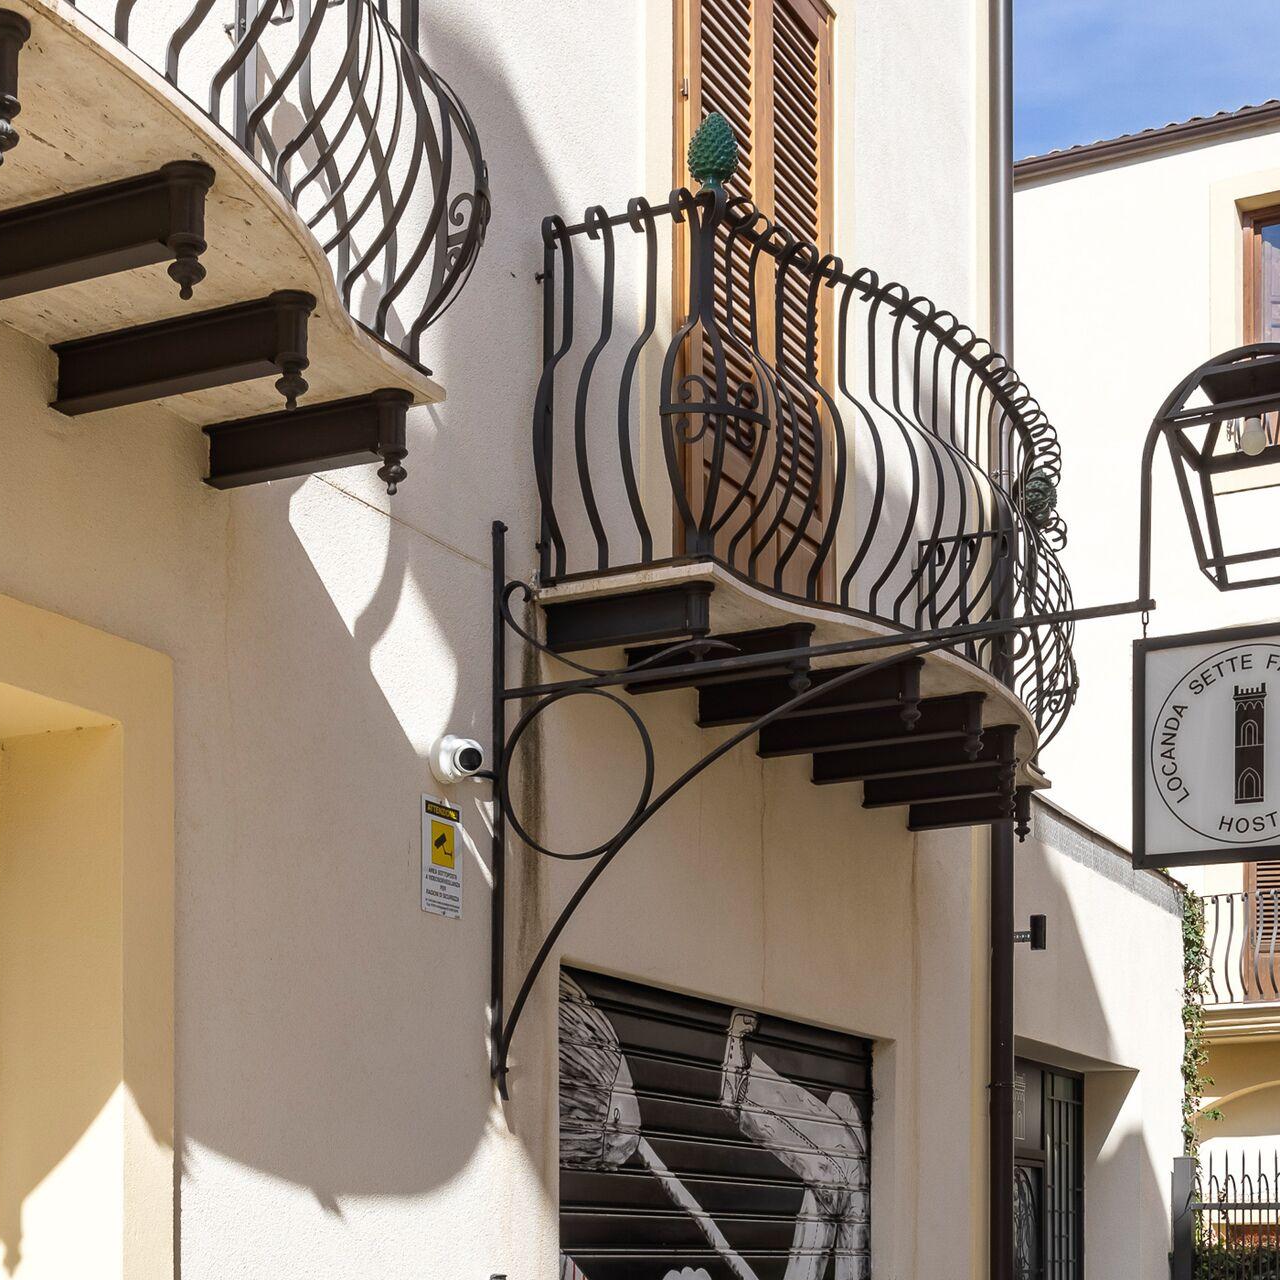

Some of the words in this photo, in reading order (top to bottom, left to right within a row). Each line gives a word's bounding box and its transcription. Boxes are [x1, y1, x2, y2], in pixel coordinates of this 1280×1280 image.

[1160, 703, 1190, 804] LOCANDA
[1188, 653, 1253, 695] SETTE
[1218, 811, 1279, 834] HOST
